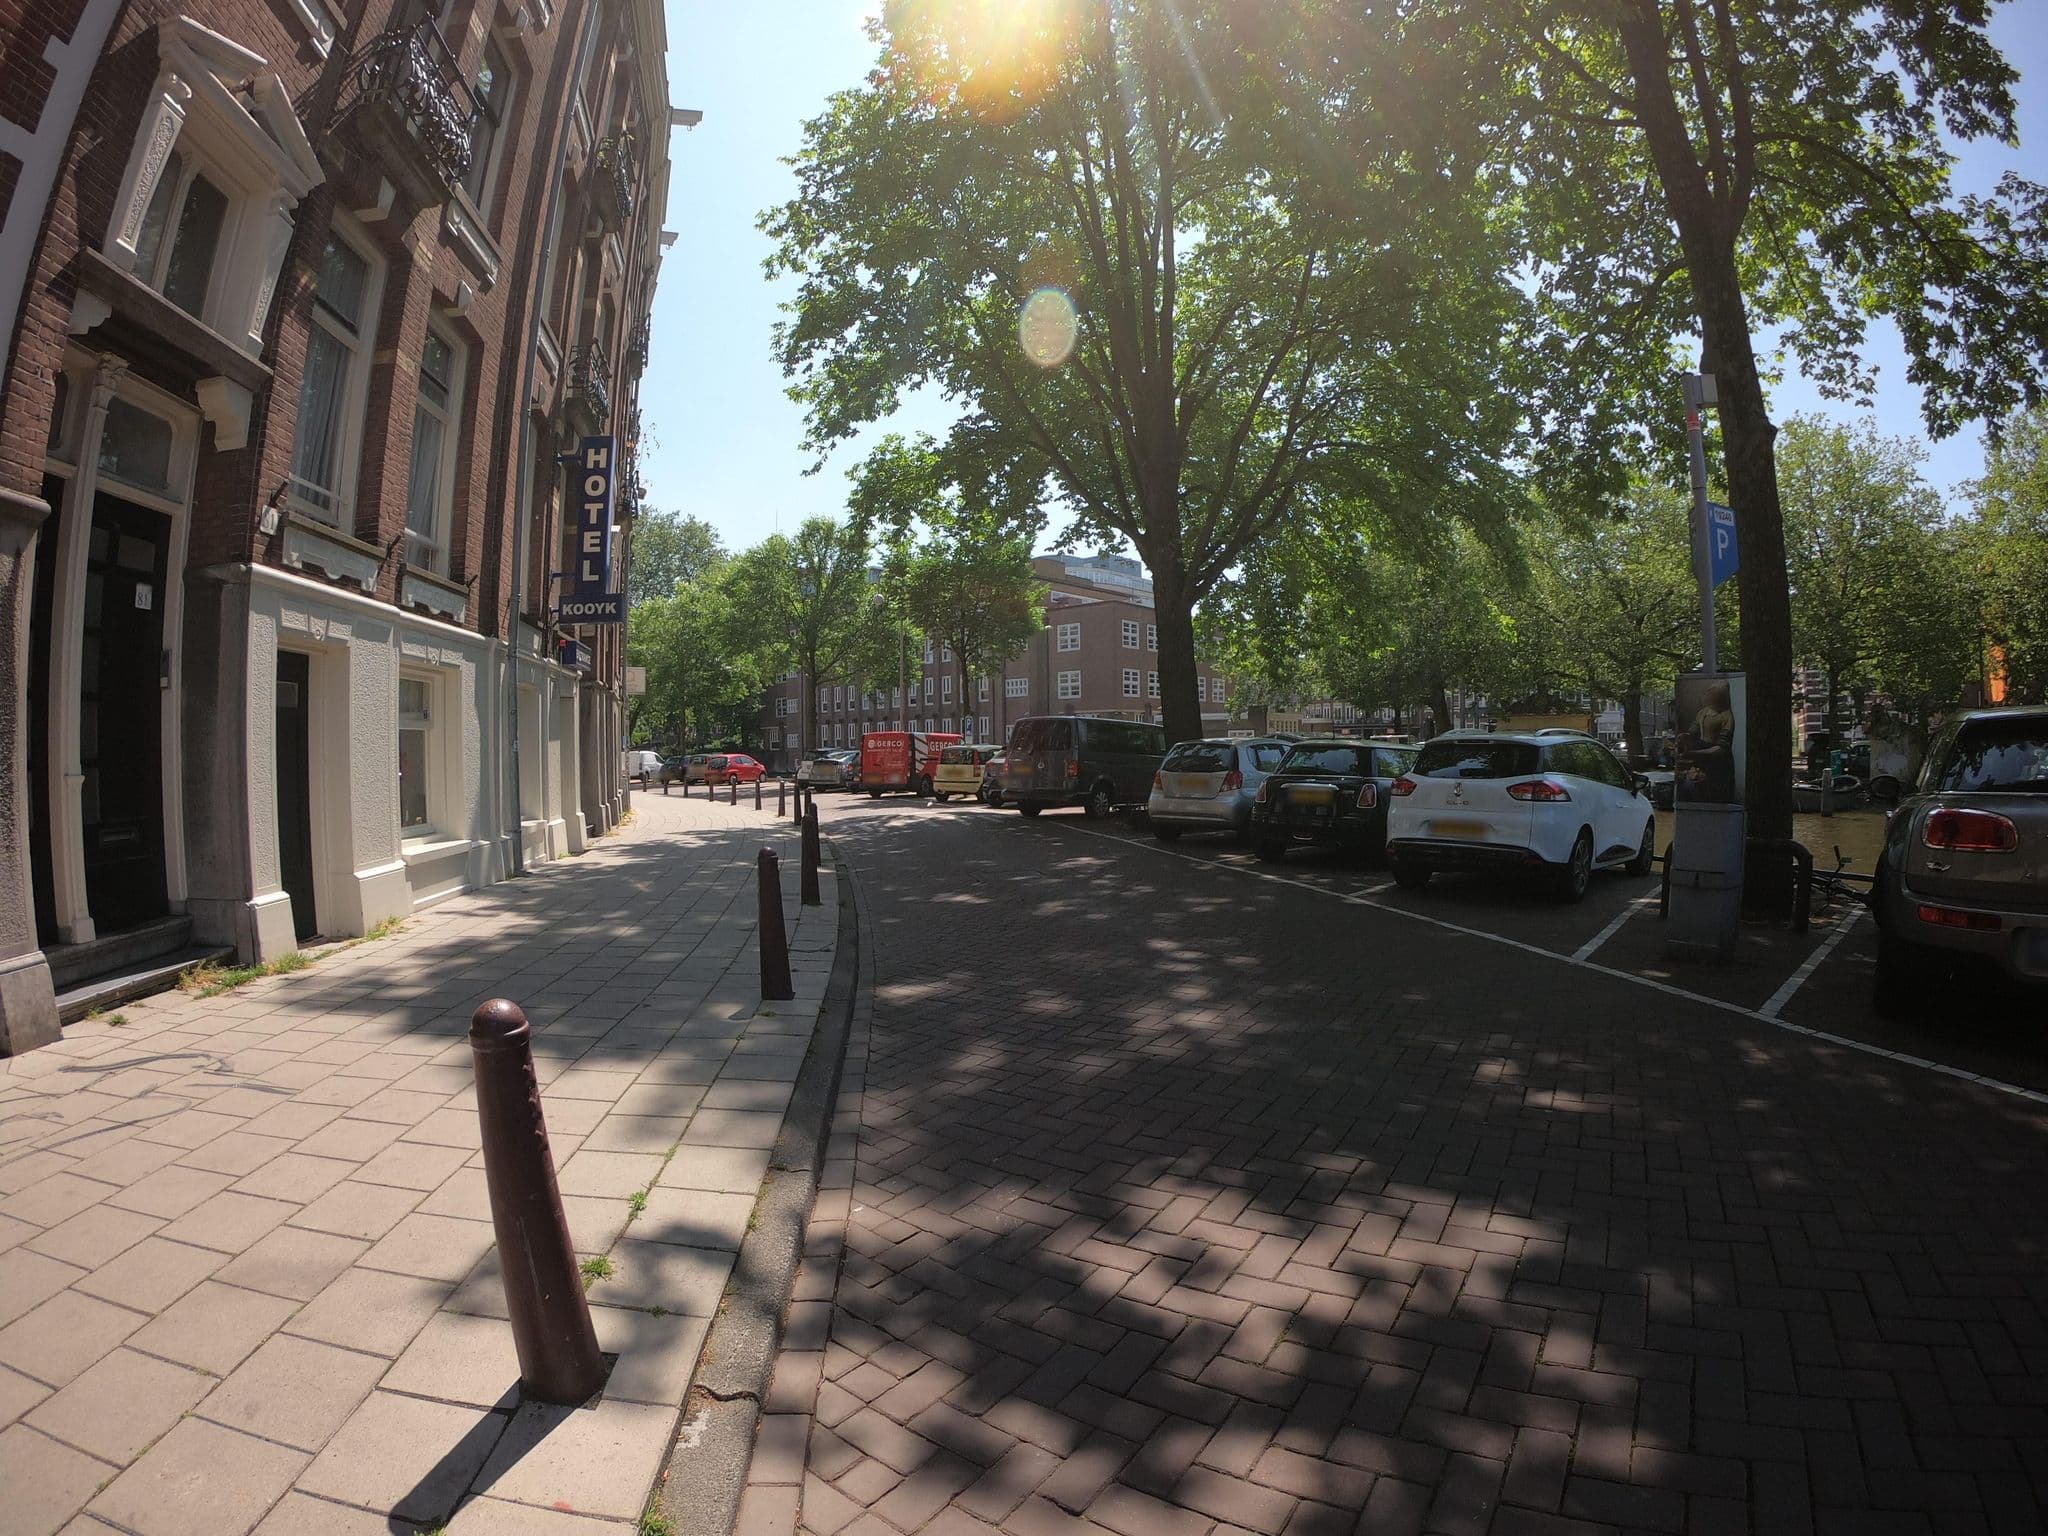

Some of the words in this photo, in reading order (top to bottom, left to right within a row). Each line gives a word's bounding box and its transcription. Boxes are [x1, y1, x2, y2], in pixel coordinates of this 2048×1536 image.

[581, 447, 608, 582] HOTEL
[1717, 527, 1729, 560] P
[137, 592, 148, 606] 81
[562, 602, 617, 616] KOOYK
